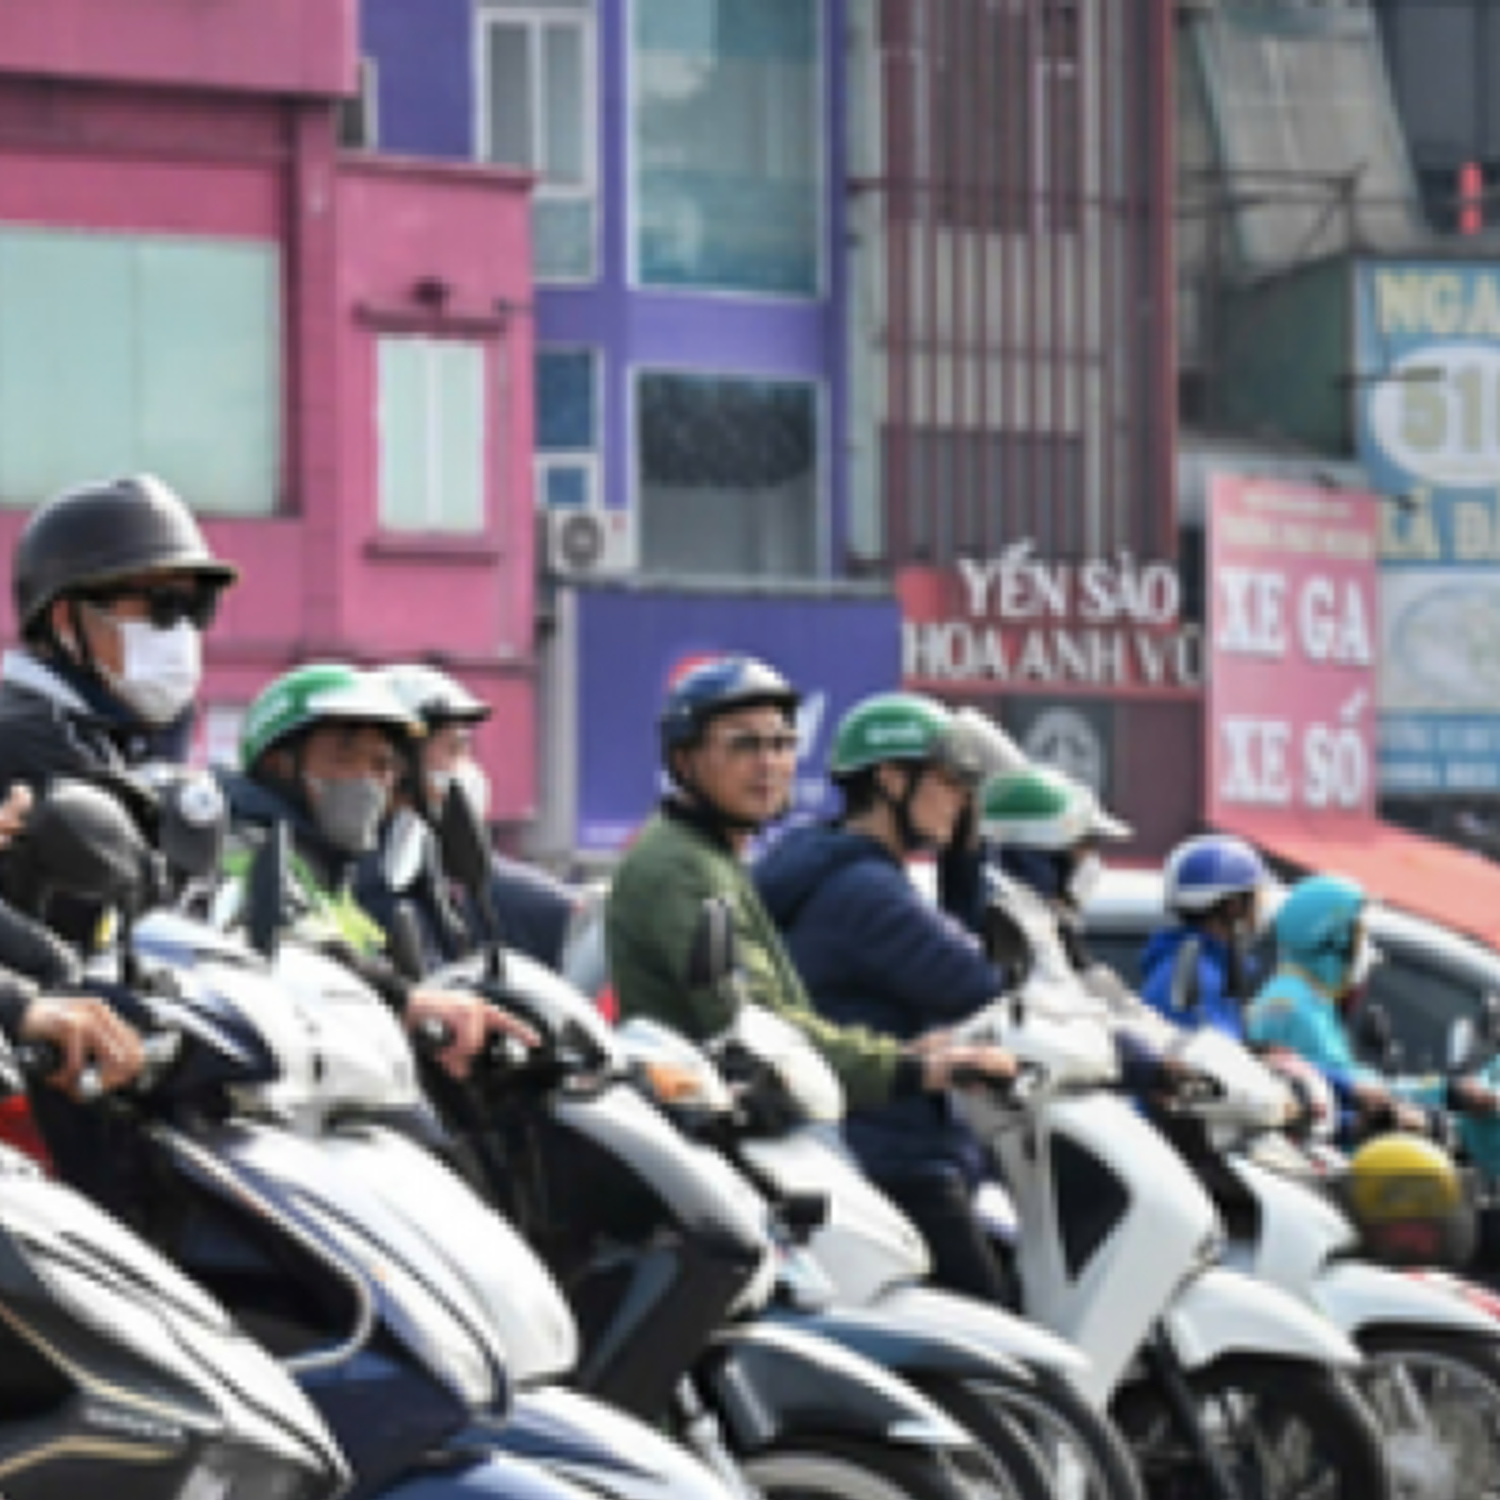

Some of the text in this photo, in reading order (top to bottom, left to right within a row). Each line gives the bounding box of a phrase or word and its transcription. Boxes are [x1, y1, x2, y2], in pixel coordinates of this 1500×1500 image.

[958, 538, 1181, 626] YẾN SÀO
[1219, 567, 1372, 668] XE GA
[902, 622, 1006, 680] HOA
[1016, 628, 1125, 684] ANH
[1219, 690, 1368, 808] XE SỐ
